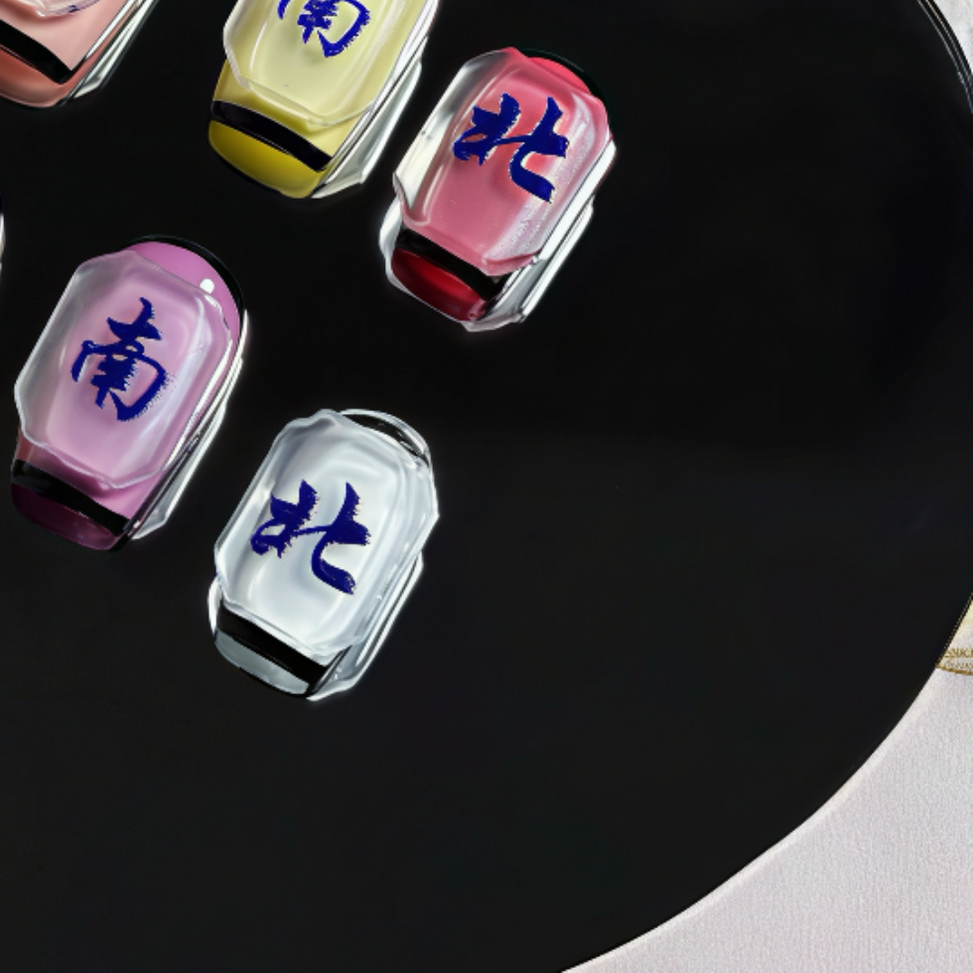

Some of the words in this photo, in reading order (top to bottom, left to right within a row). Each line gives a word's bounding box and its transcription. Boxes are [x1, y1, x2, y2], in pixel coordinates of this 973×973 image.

[454, 93, 568, 202] 北
[71, 298, 168, 421] 南
[251, 480, 372, 594] 北
